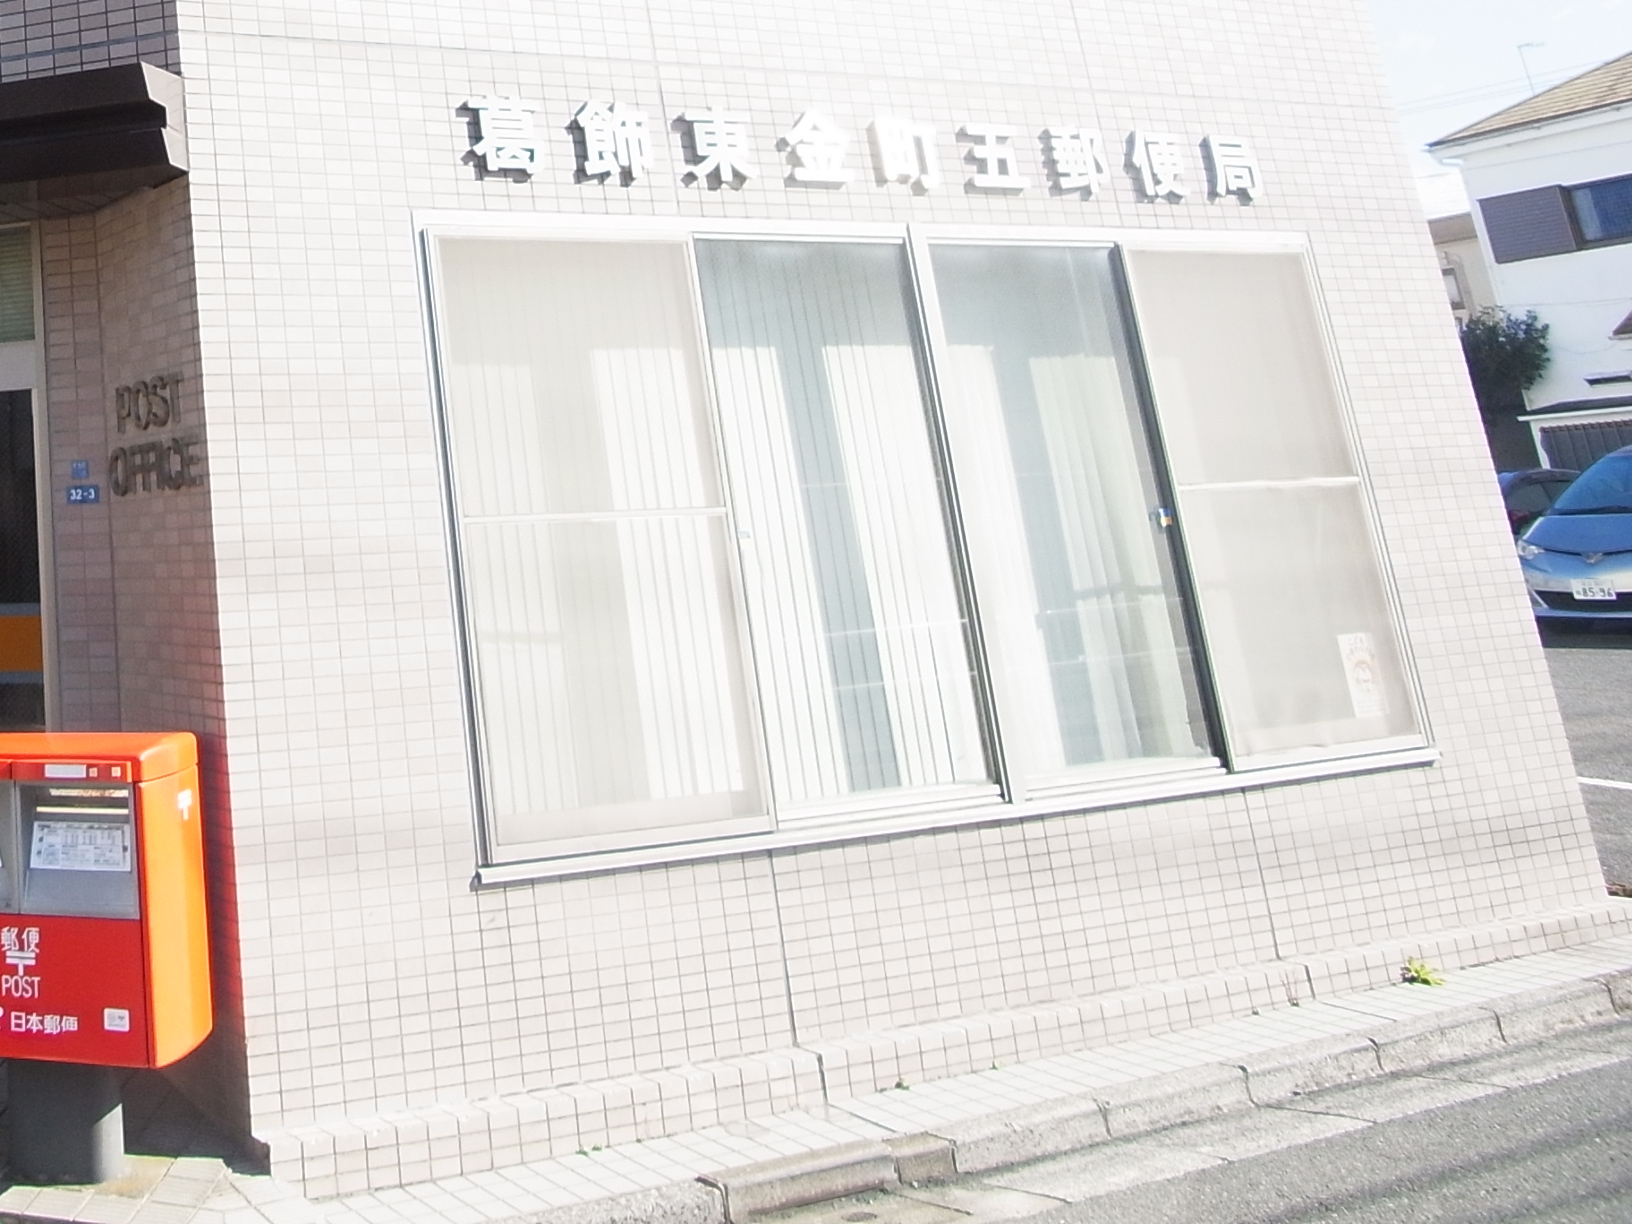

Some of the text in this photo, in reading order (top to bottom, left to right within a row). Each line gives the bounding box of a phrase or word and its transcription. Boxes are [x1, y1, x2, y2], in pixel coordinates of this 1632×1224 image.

[461, 94, 1264, 206] 葛飾東金町五郵便局
[115, 371, 185, 434] POST
[110, 434, 204, 497] OFFICE
[70, 488, 95, 500] 32-3
[0, 926, 40, 953] 郵便
[1, 974, 41, 999] POST
